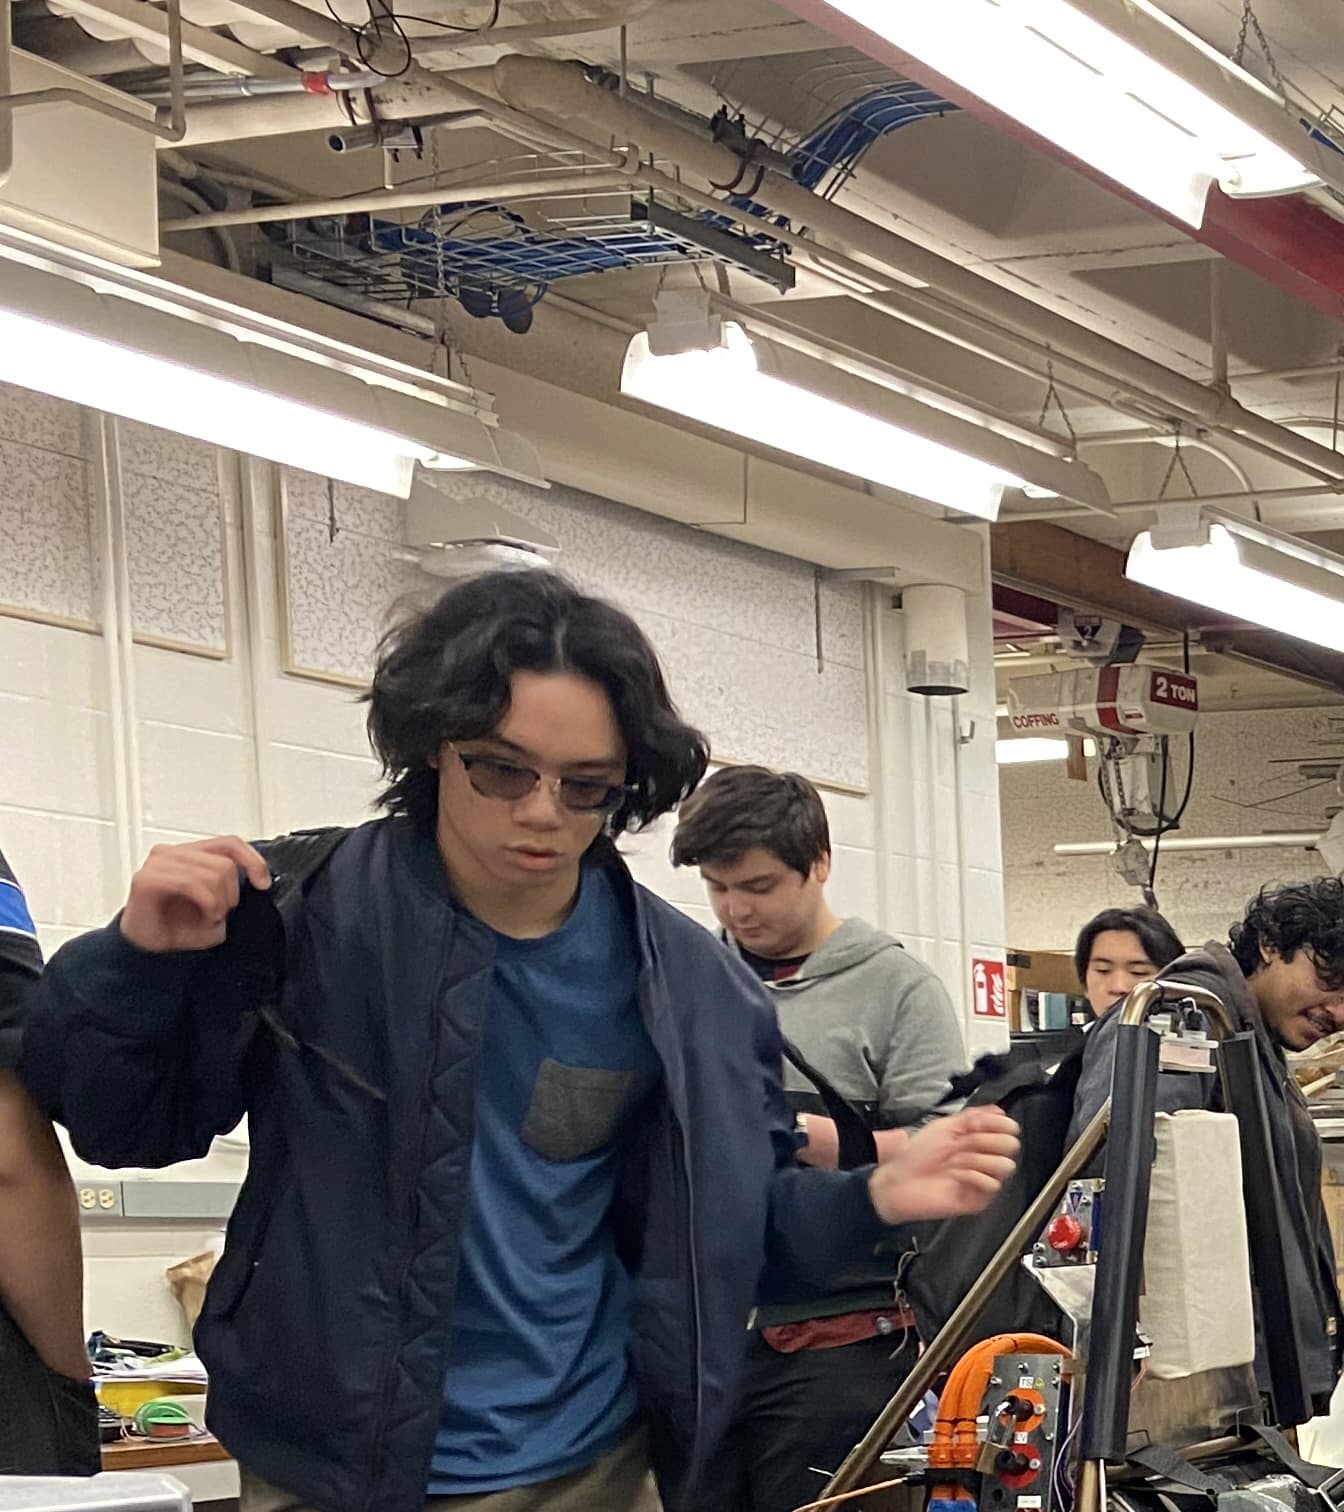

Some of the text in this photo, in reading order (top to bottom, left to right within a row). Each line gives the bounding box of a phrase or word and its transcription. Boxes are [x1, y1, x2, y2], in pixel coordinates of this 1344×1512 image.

[1156, 676, 1196, 702] 2 TON
[1012, 712, 1060, 730] COFFING
